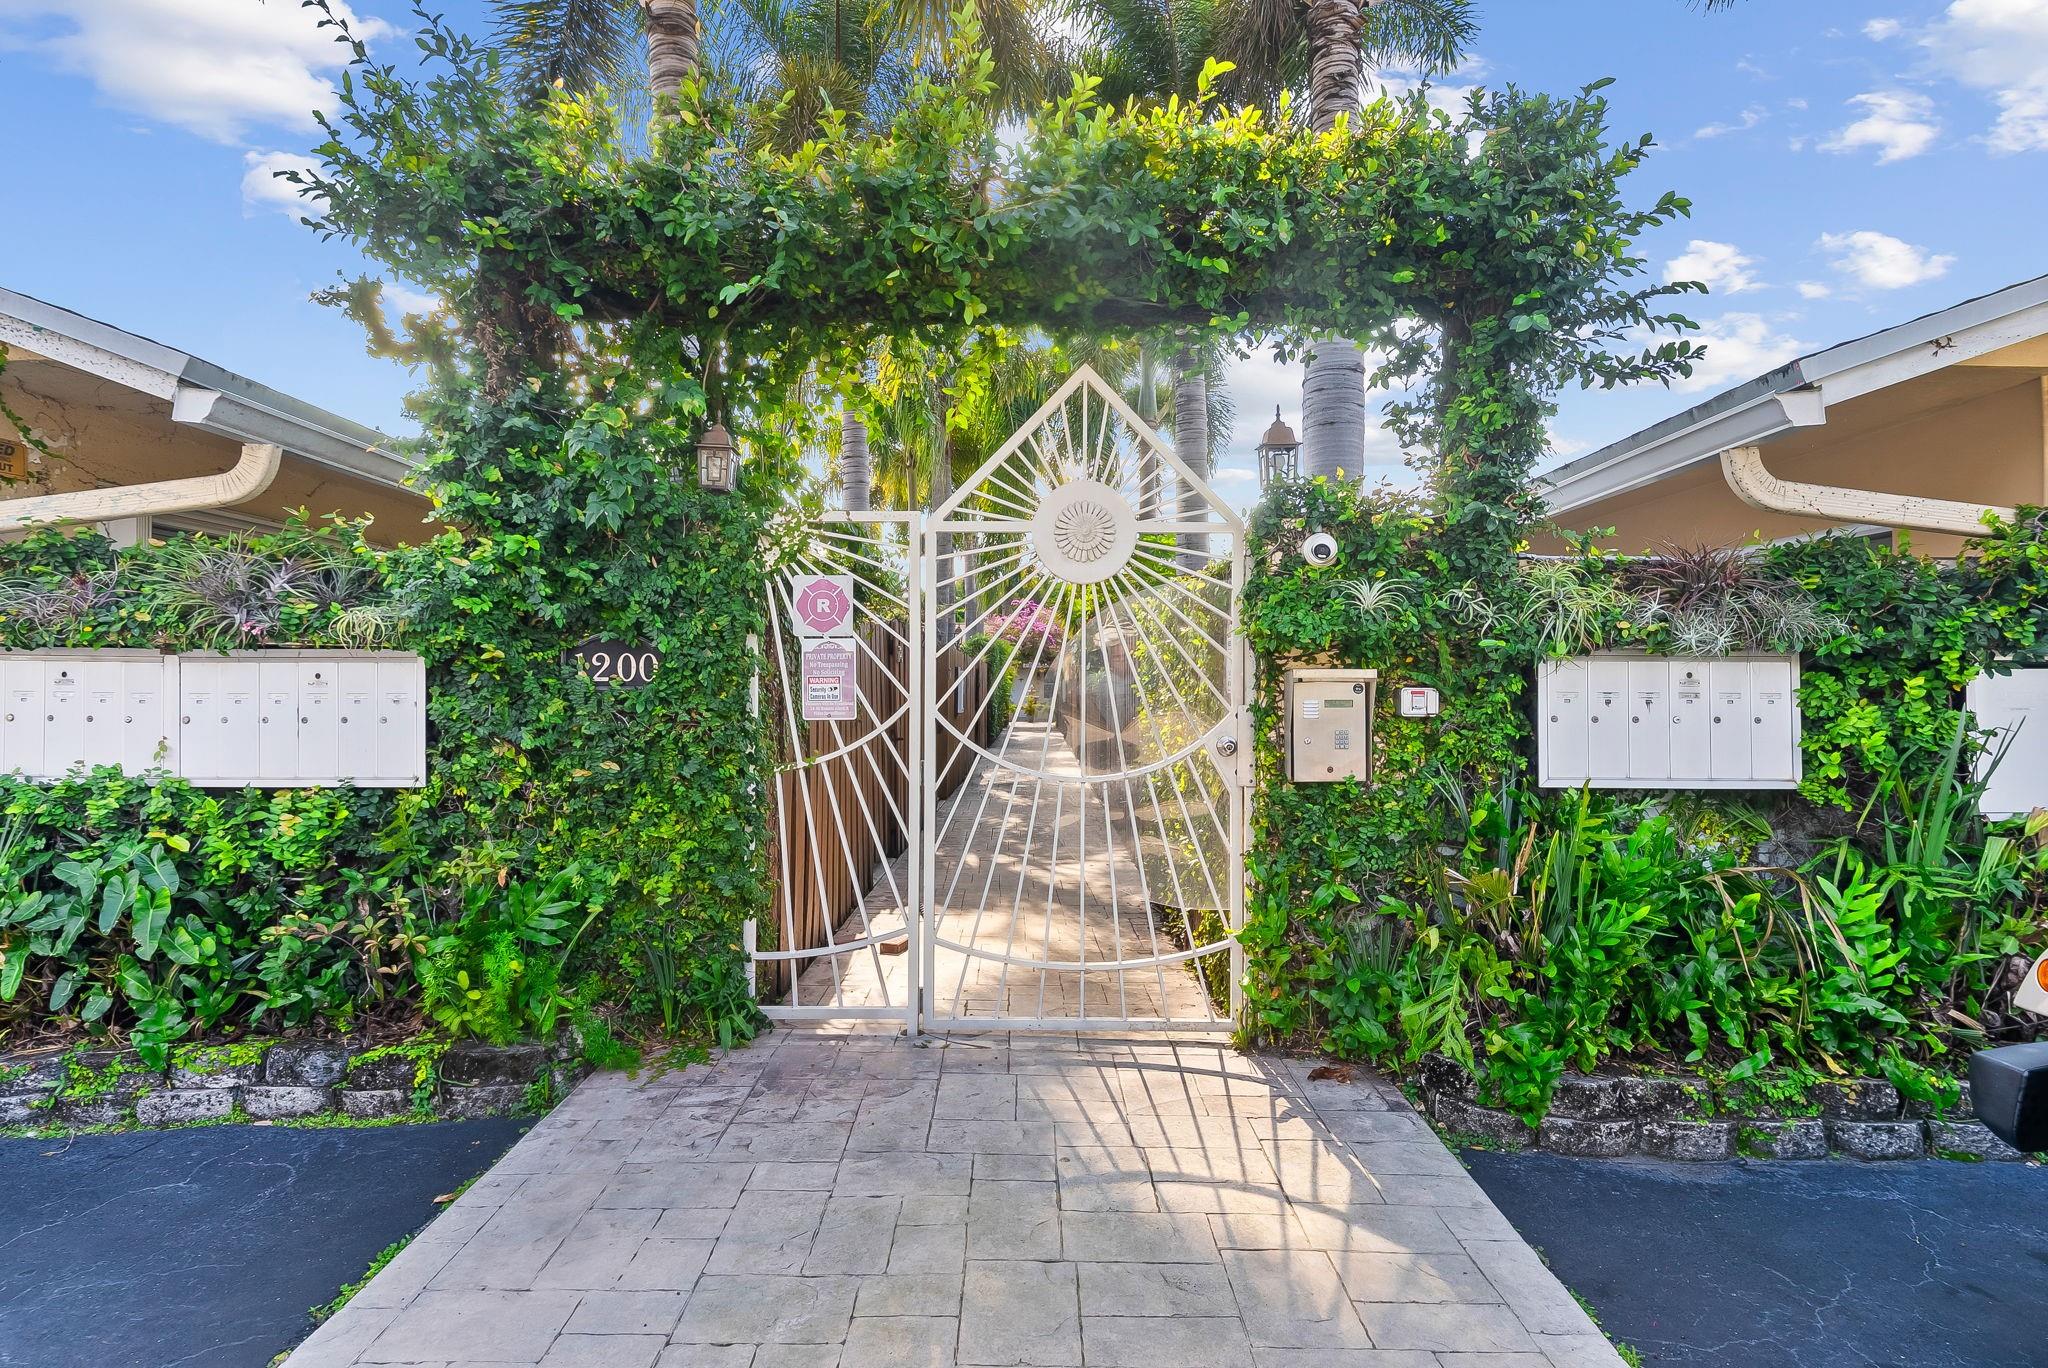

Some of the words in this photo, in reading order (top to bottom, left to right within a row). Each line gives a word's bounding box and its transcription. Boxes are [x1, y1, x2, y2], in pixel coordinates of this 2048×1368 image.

[816, 598, 831, 613] R
[818, 661, 849, 669] Trespassing
[810, 686, 827, 694] Security
